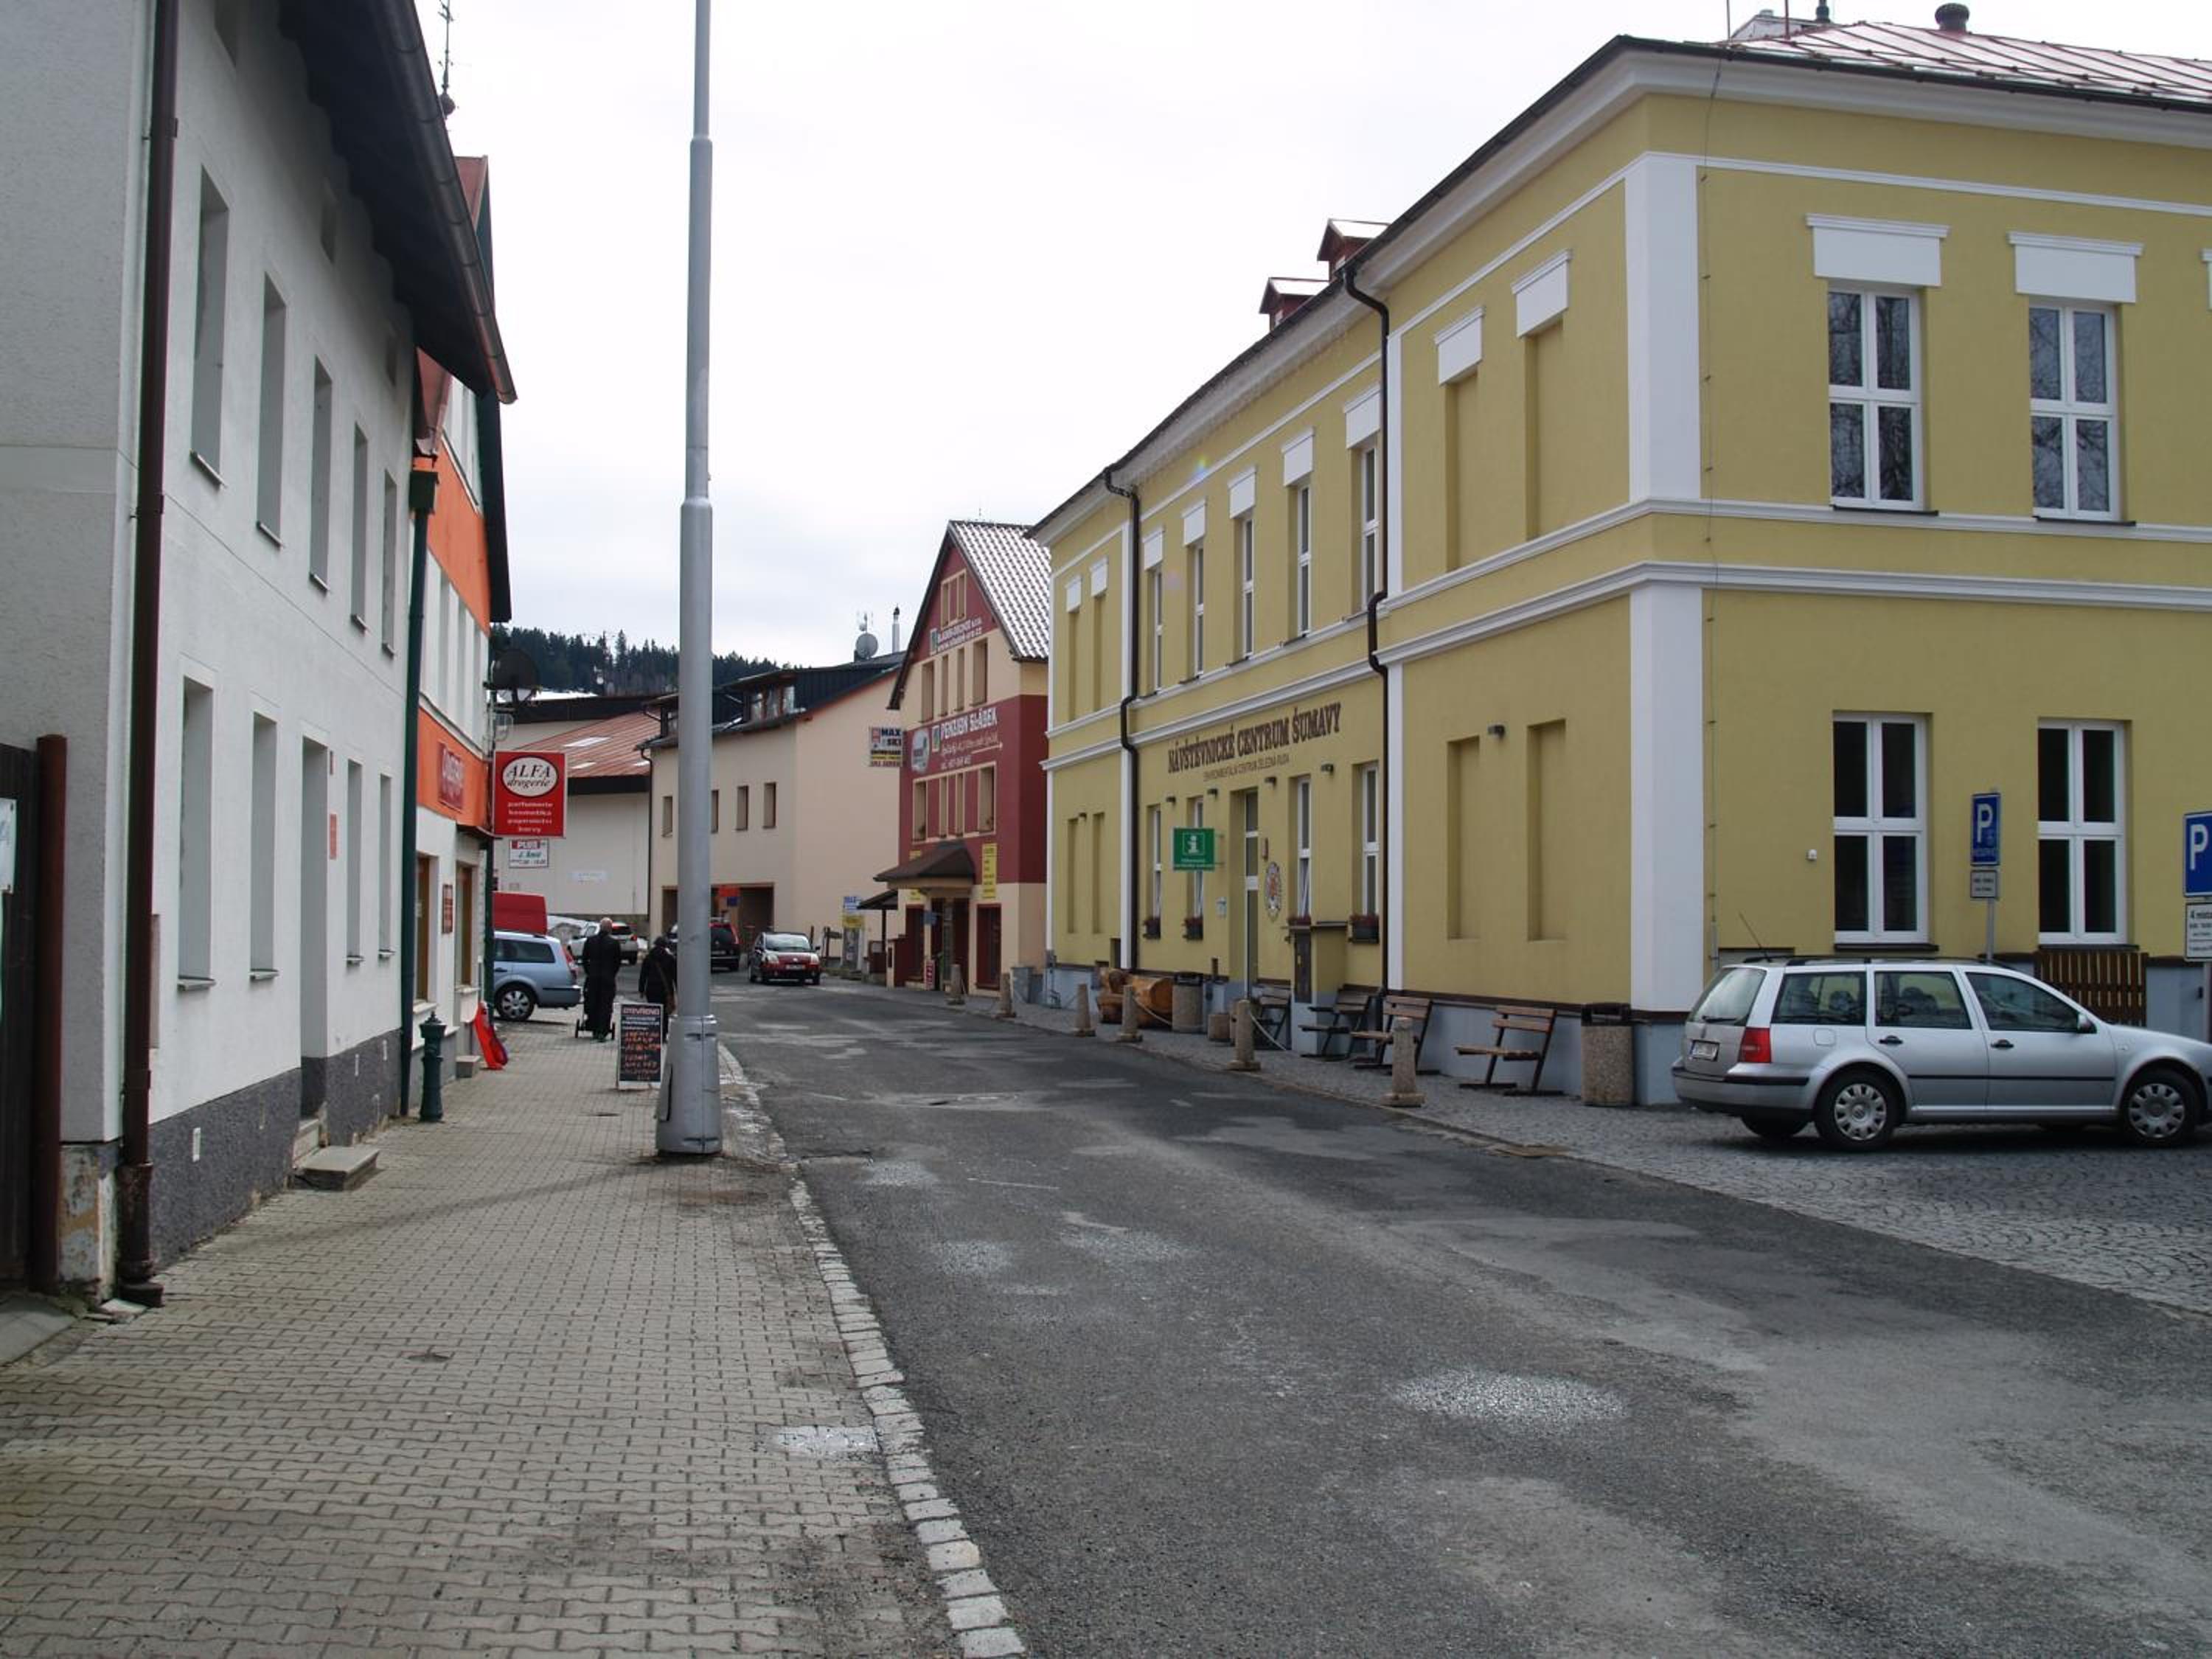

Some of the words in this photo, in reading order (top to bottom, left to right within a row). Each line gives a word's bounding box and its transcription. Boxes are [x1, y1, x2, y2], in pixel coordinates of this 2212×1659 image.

[1168, 723, 1235, 773] NÁVŠTĚVNICKÉ
[1237, 717, 1290, 757] CENTRUM
[1292, 703, 1341, 744] ŠUMAVY
[507, 765, 551, 777] ALFA
[507, 777, 552, 789] drogerie
[1977, 803, 1993, 843] P
[2190, 824, 2208, 870] P
